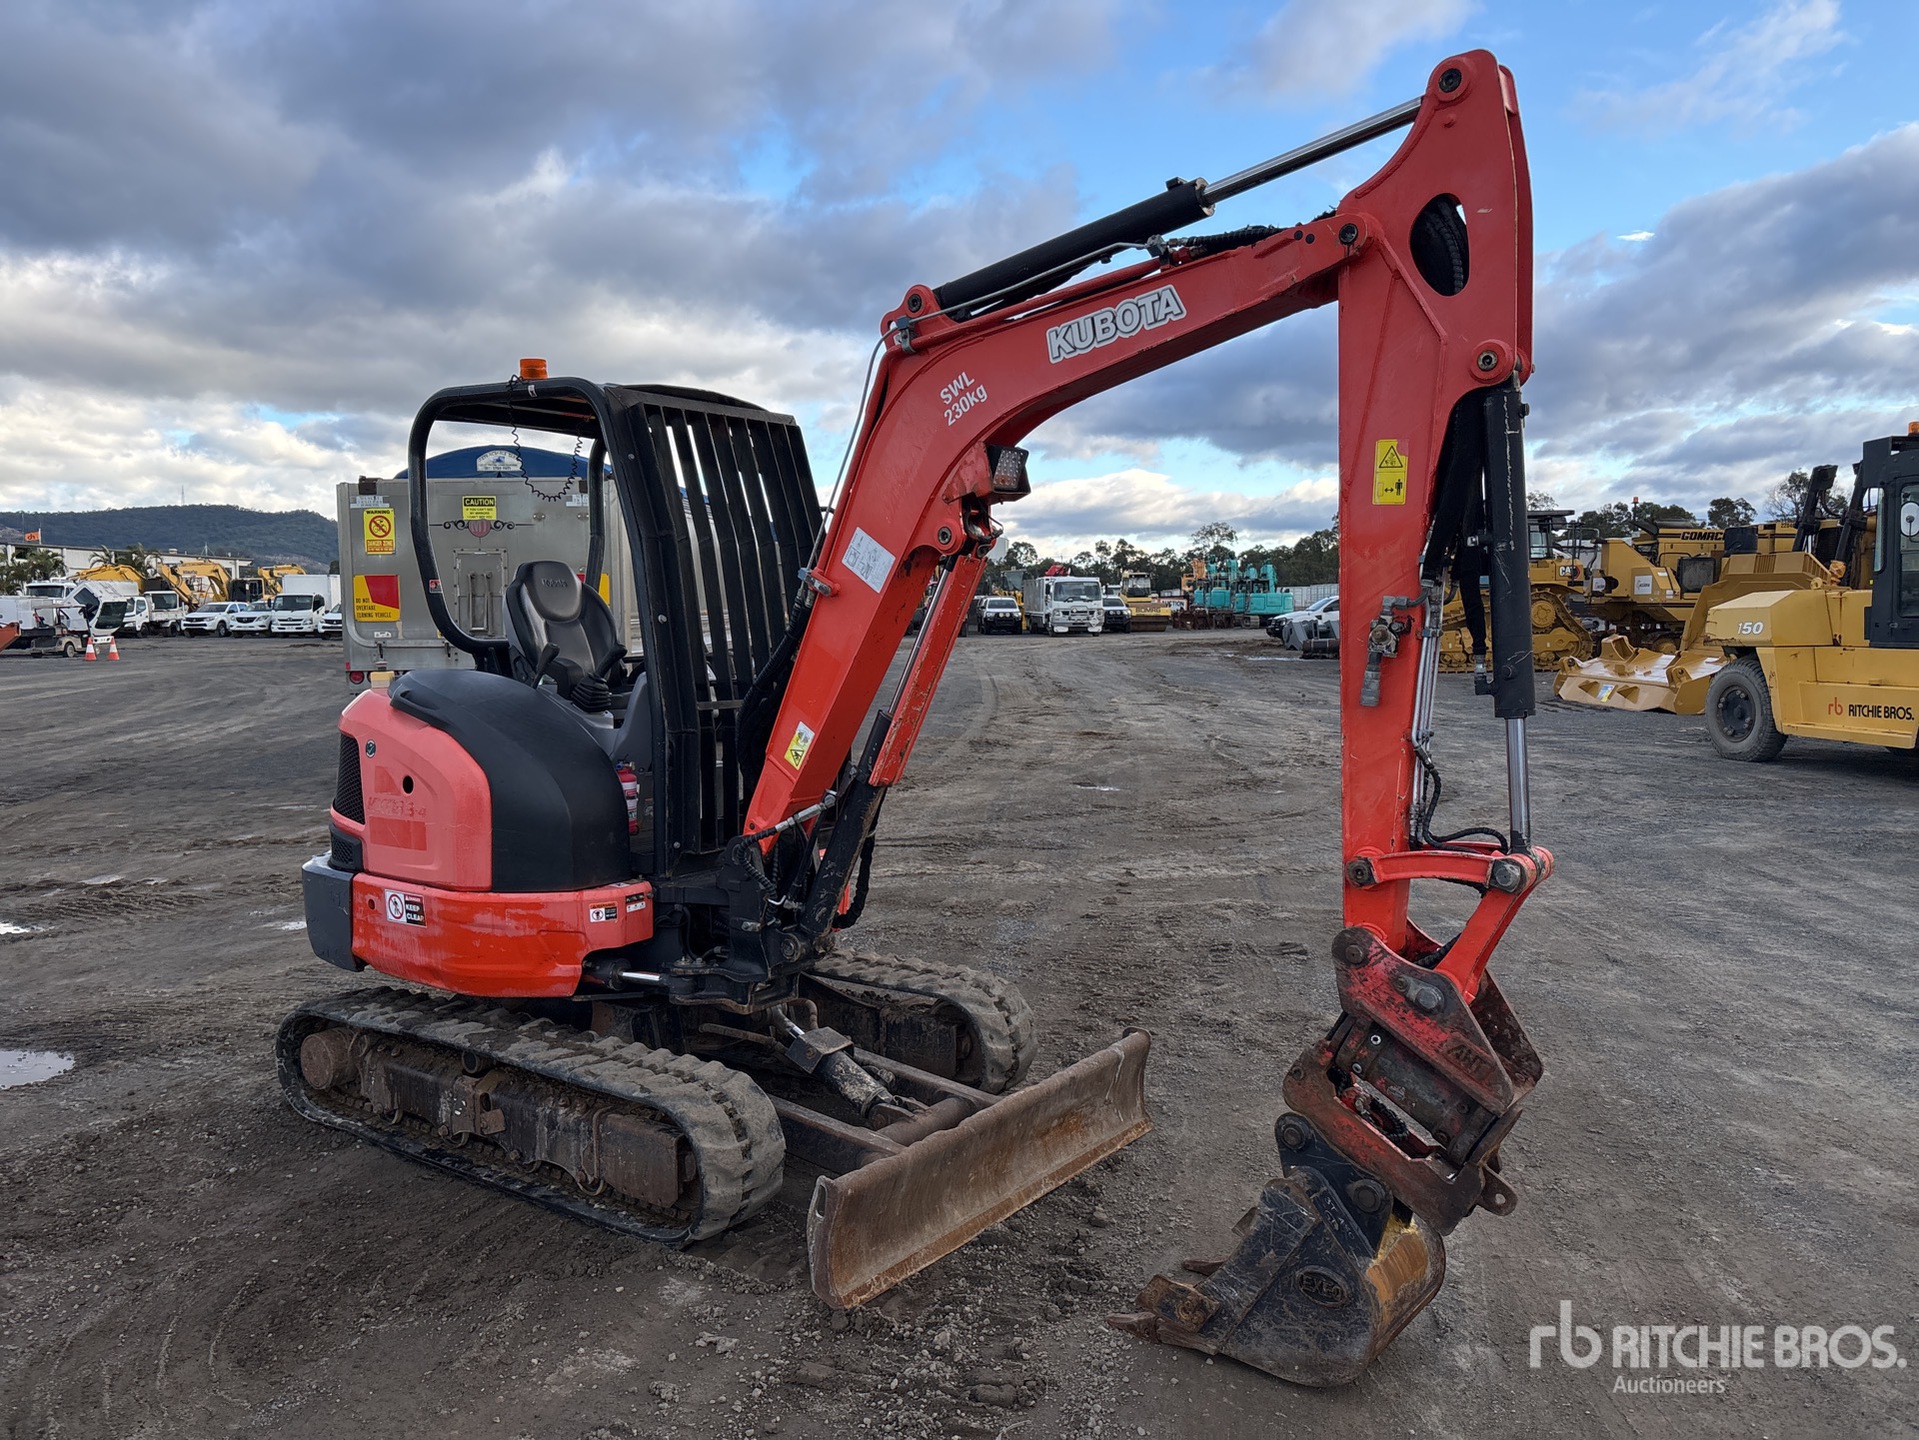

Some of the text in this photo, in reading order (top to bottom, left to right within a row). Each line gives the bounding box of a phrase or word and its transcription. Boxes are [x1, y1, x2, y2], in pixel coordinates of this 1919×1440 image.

[1047, 286, 1186, 362] KUBOTA
[940, 371, 975, 405] SWL
[944, 385, 988, 427] 230kg
[465, 498, 494, 506] CAUTION
[1681, 531, 1724, 540] GOMAC
[1738, 622, 1764, 635] 150
[1828, 697, 1915, 721] rb RITCHIE BROS.
[406, 903, 420, 911] KEEP
